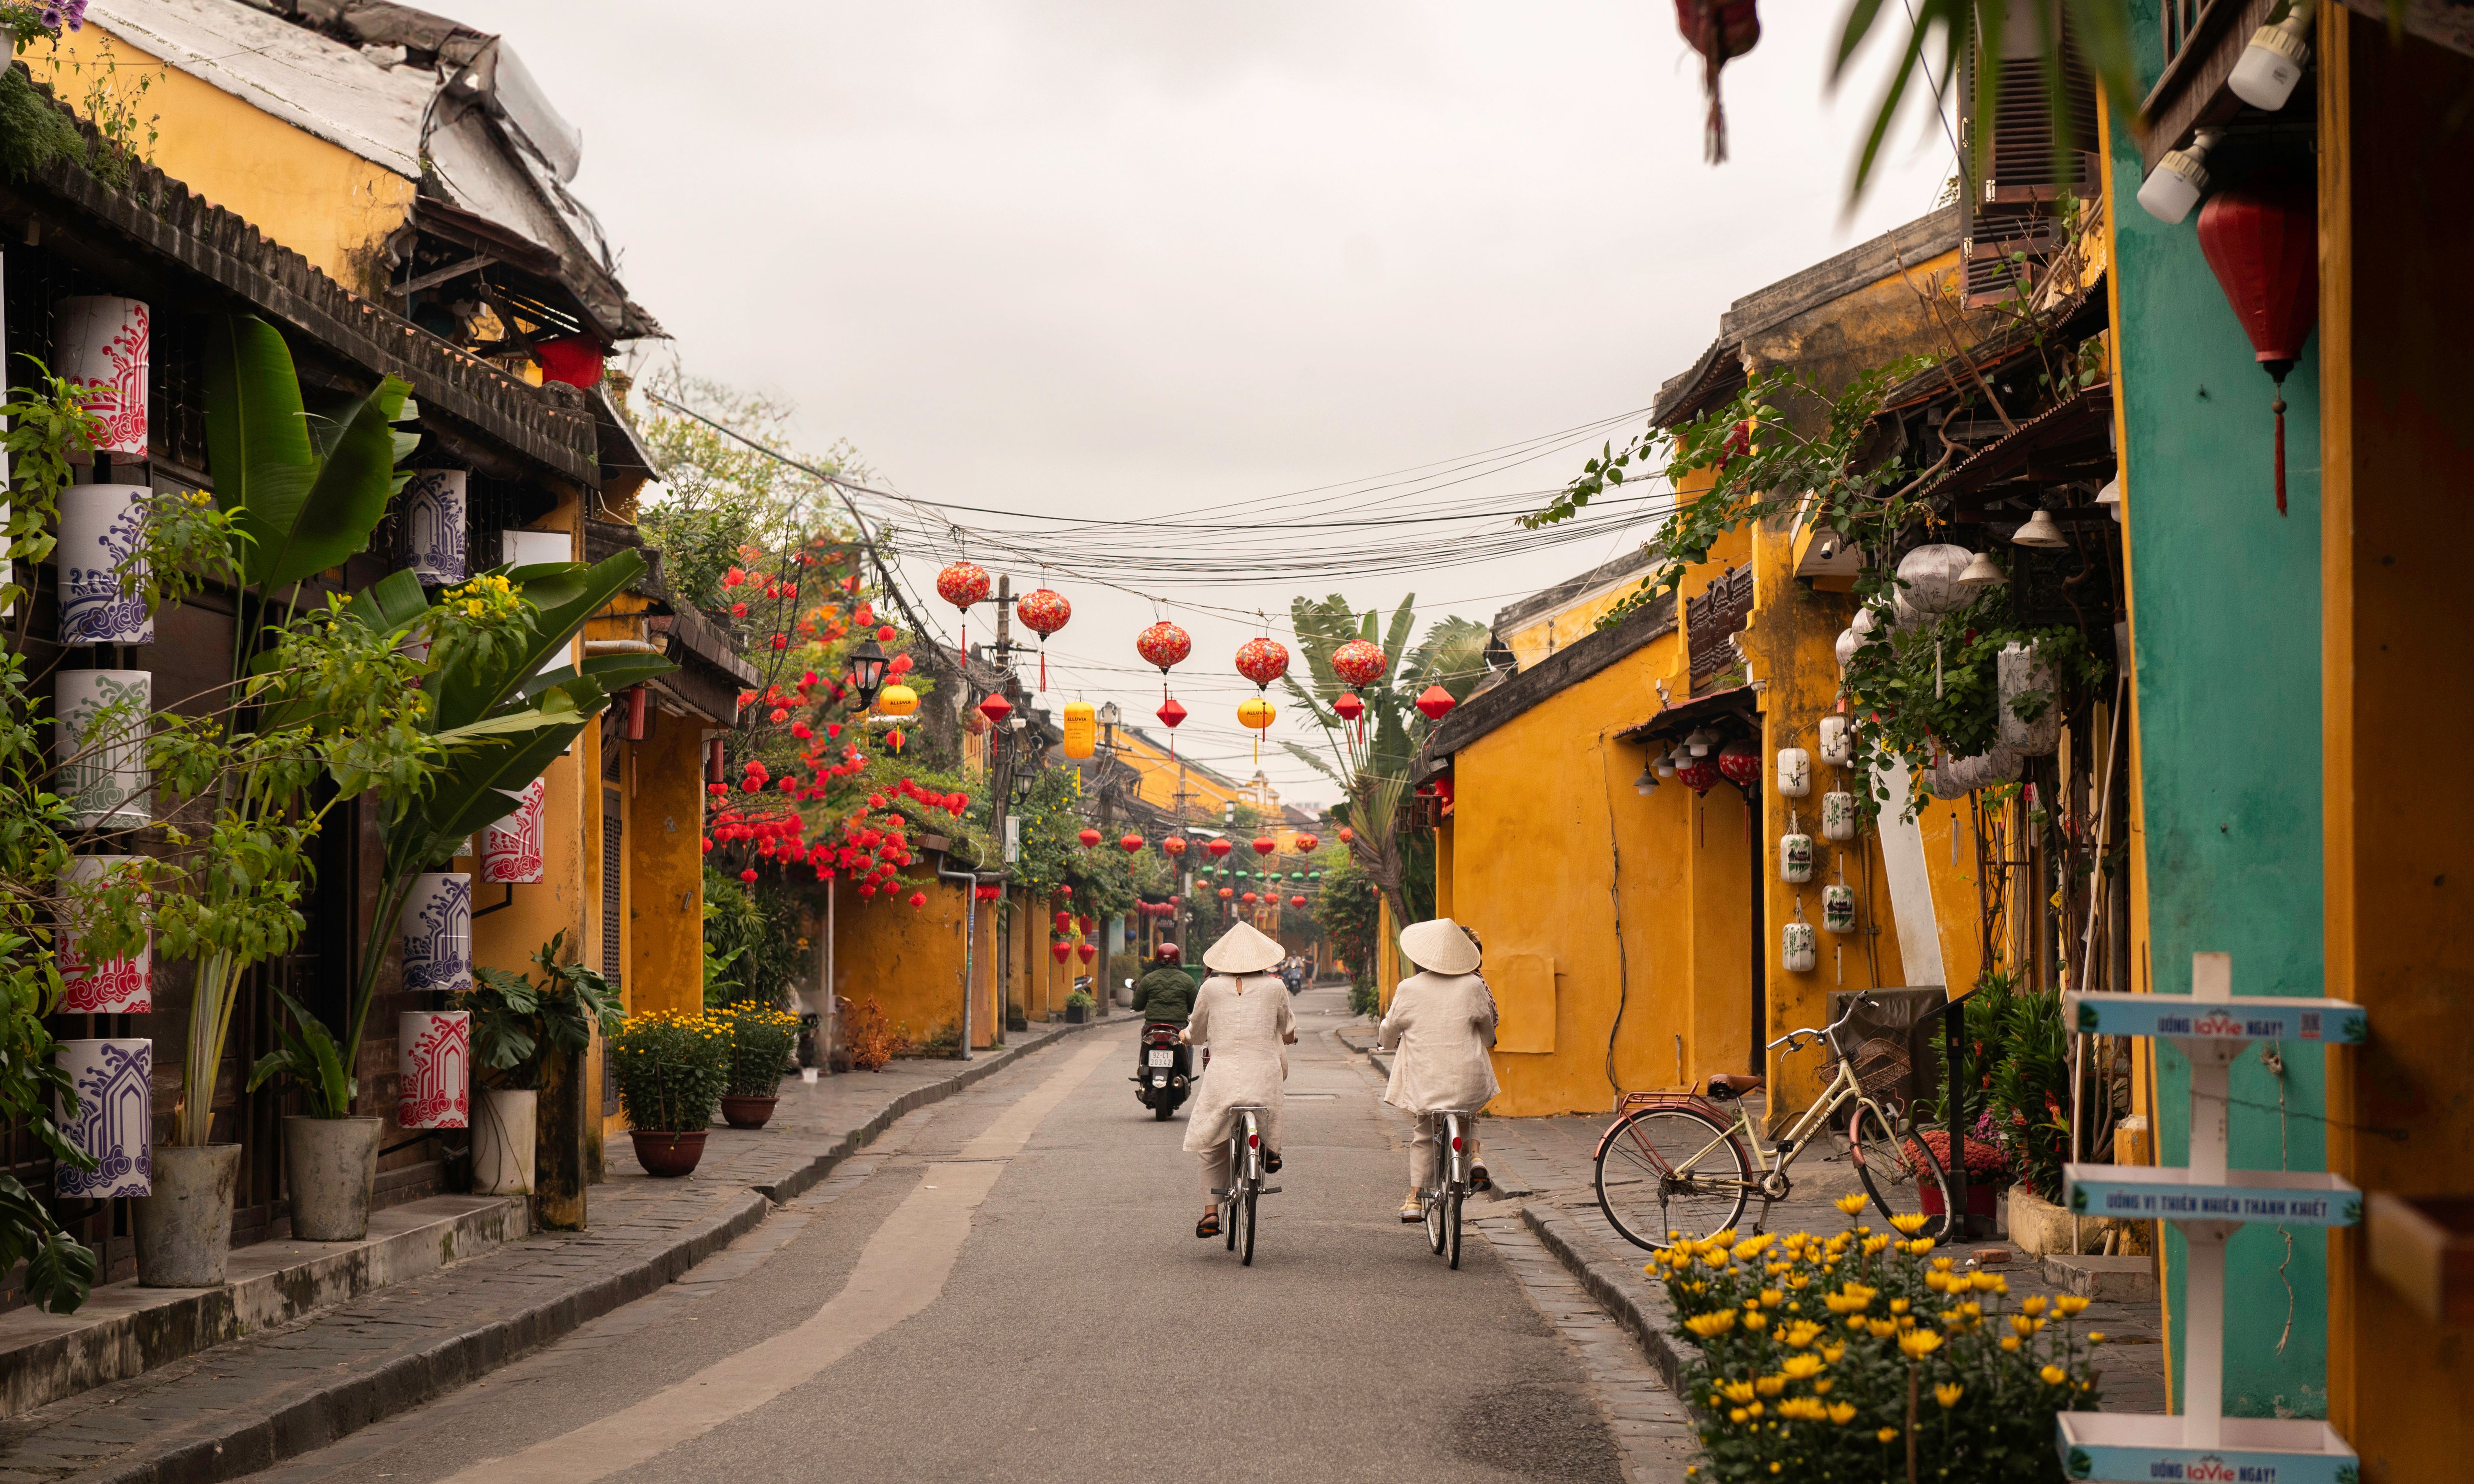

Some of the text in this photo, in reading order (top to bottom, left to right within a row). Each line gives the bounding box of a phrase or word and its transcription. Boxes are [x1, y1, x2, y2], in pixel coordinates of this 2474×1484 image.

[1804, 1111, 1829, 1142] ASAMA
[2244, 1199, 2286, 1215] THANH
[2239, 1467, 2275, 1483] NGAY!
